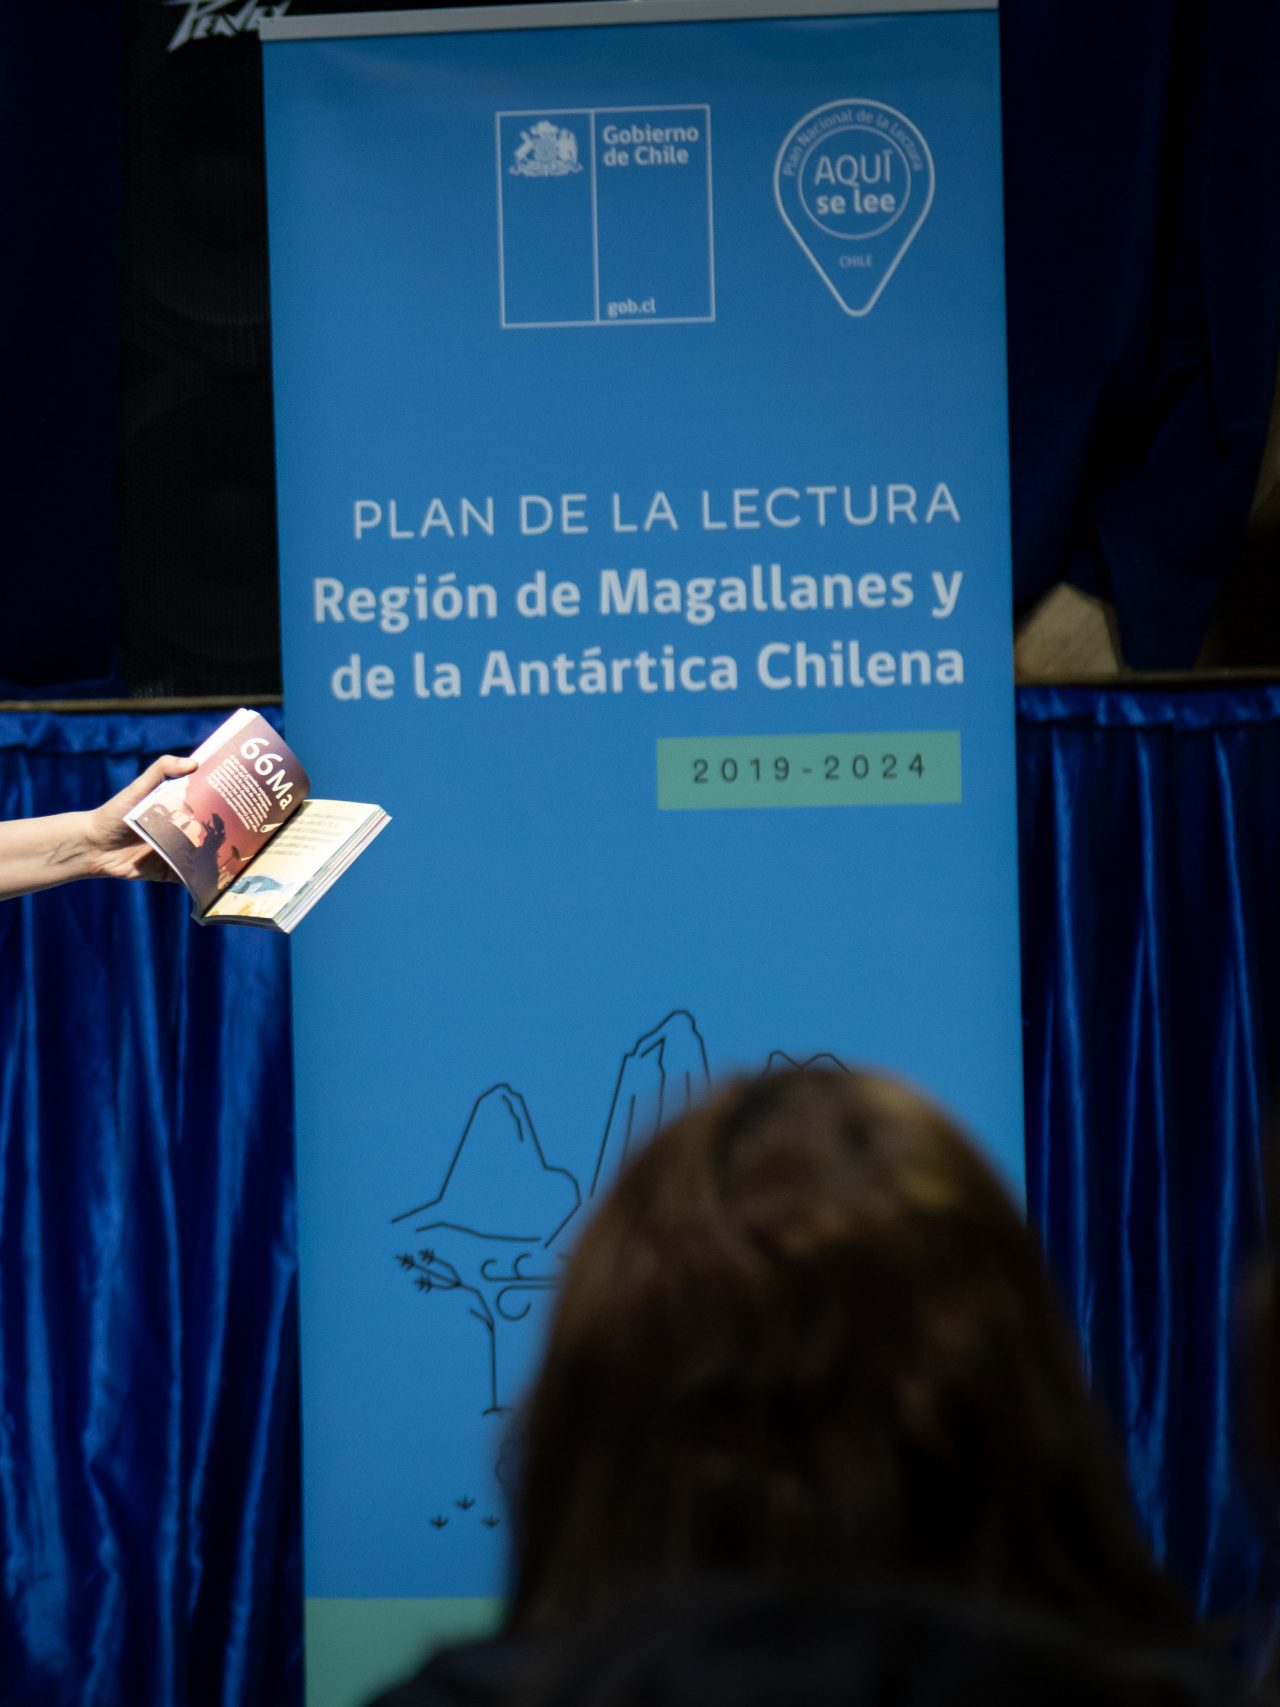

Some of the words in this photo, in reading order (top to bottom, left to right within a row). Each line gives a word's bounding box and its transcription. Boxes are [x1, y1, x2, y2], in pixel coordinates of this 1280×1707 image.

[603, 123, 699, 145] Gobierno
[797, 109, 853, 147] Nacional
[856, 109, 874, 124] de
[876, 111, 889, 130] la
[889, 121, 924, 172] Lectura
[604, 147, 629, 167] de
[635, 144, 689, 165] Chile
[816, 194, 847, 215] se
[853, 187, 896, 214] lee
[838, 254, 874, 268] CHILE
[607, 296, 656, 319] gob.cl
[353, 496, 495, 540] PLAN
[519, 493, 589, 535] DE
[612, 491, 679, 533] LA
[702, 483, 961, 530] LECTURA
[313, 572, 498, 634] Región
[515, 570, 581, 618] de
[599, 563, 914, 626] Magallanes
[931, 571, 963, 619] y
[331, 653, 396, 701] de
[413, 651, 462, 699] la
[479, 644, 738, 697] Antártica
[756, 639, 964, 690] Chilena
[692, 753, 924, 784] 2019-2024
